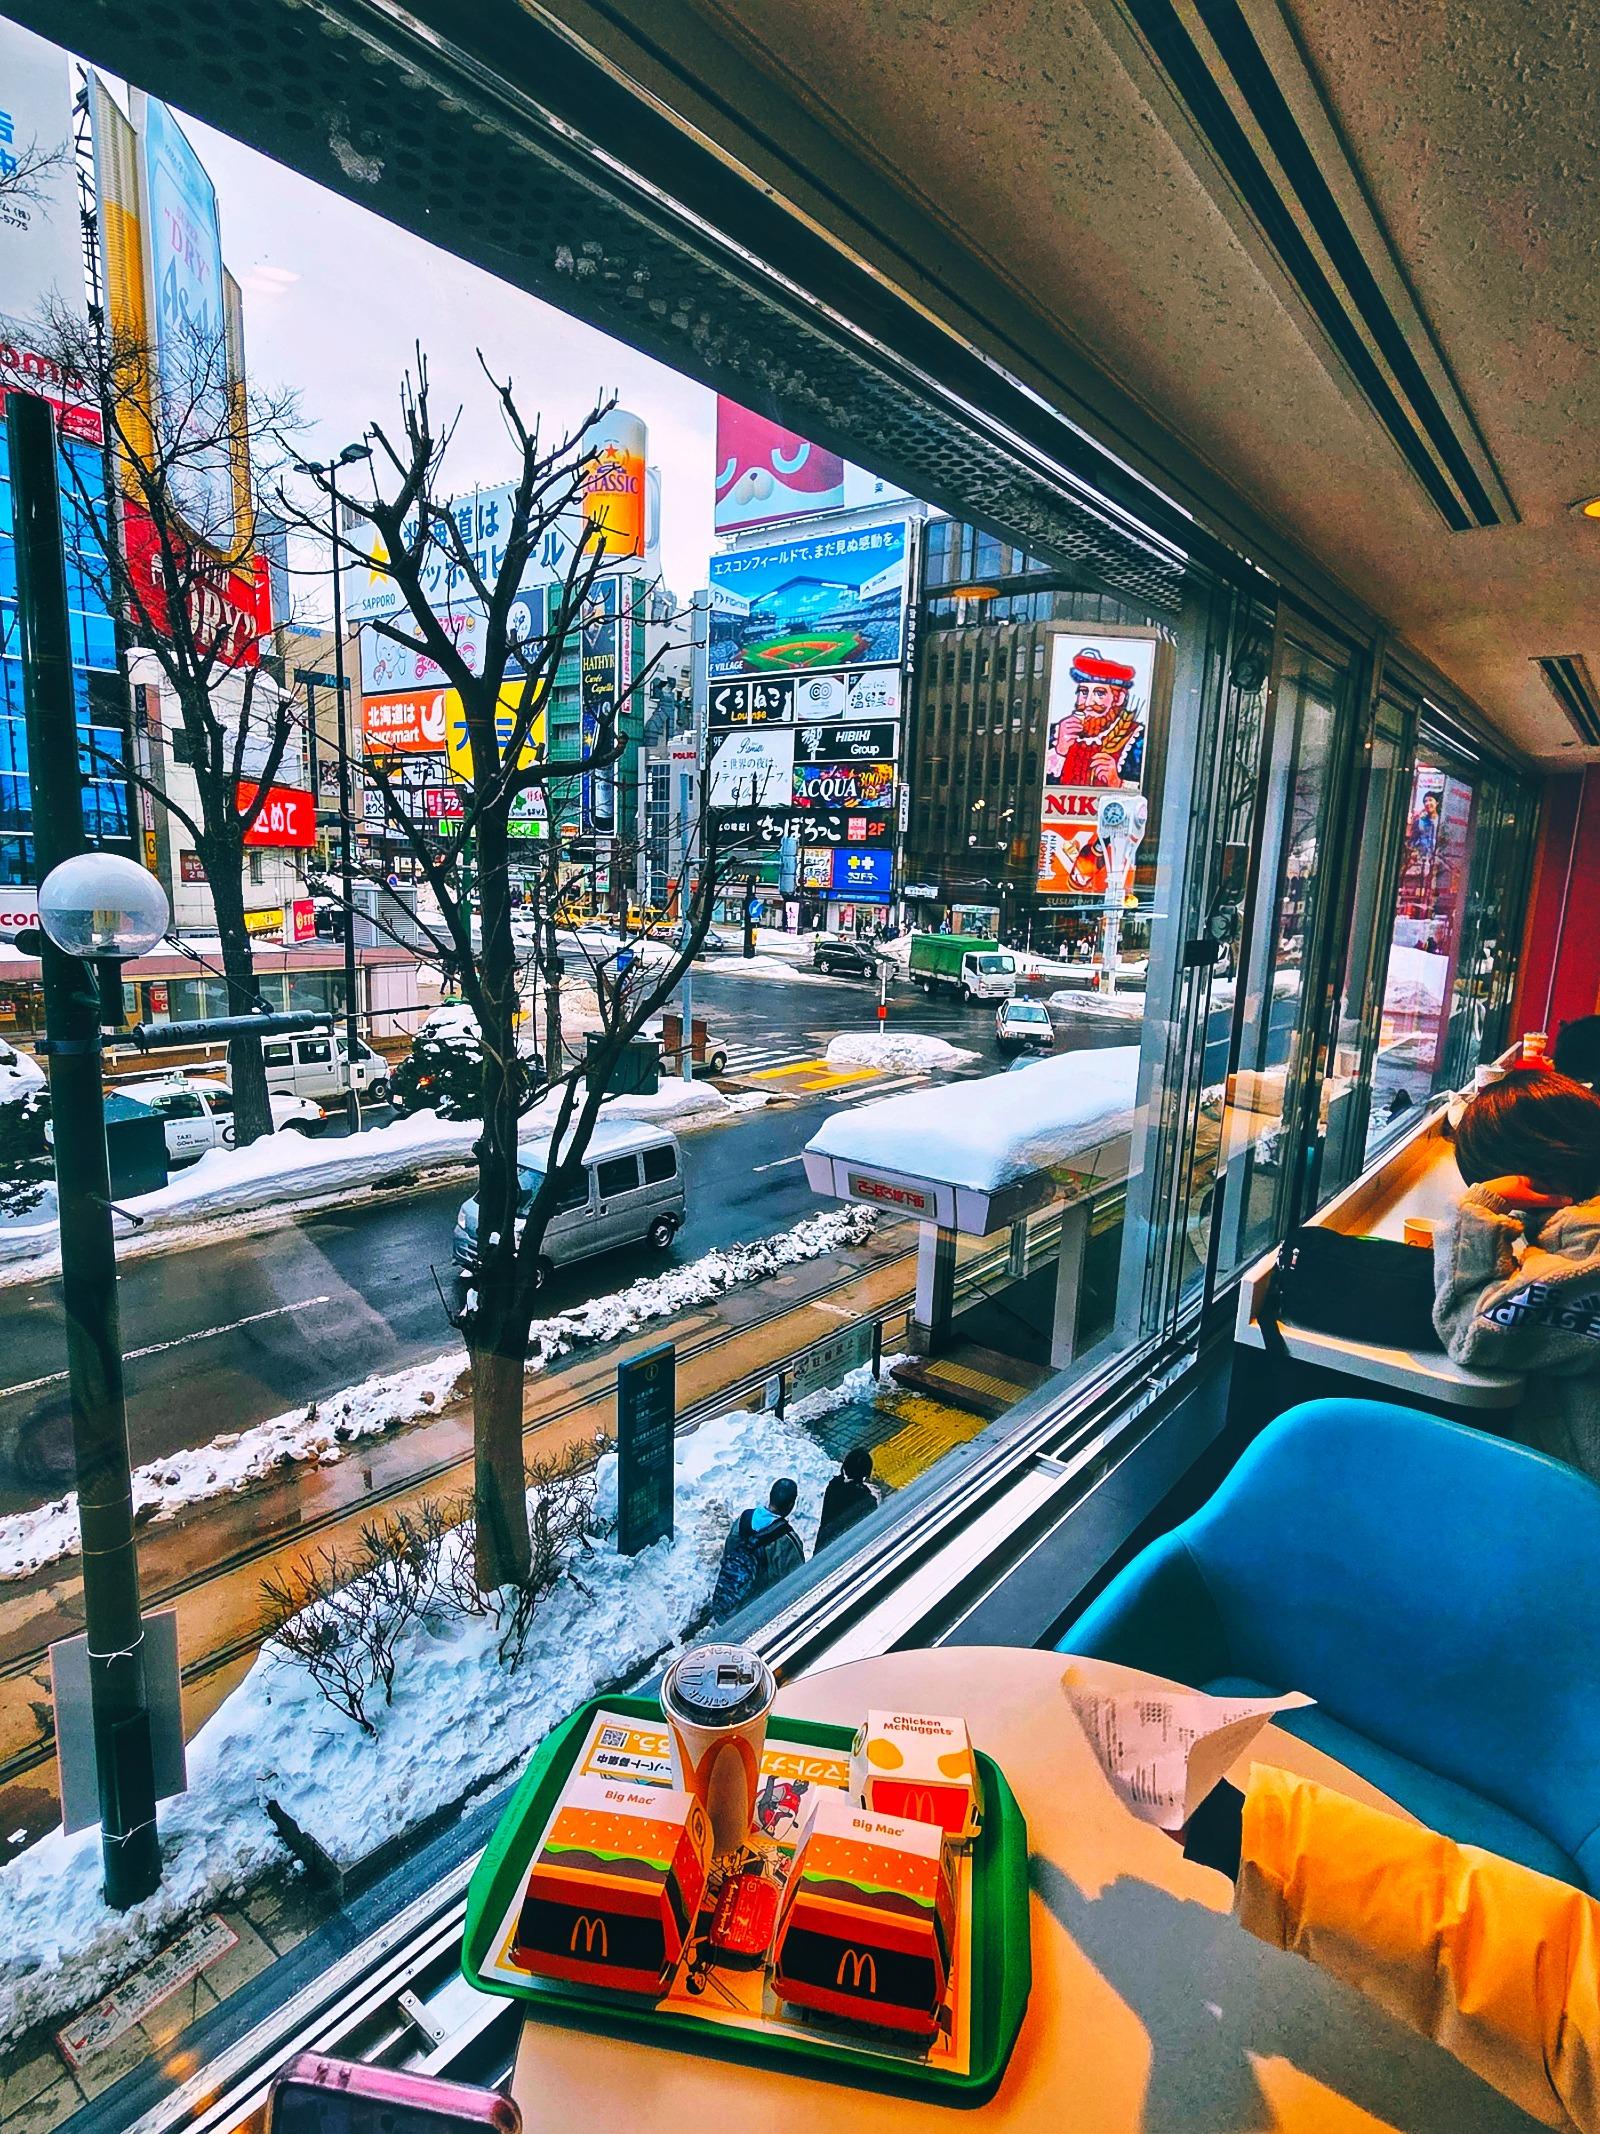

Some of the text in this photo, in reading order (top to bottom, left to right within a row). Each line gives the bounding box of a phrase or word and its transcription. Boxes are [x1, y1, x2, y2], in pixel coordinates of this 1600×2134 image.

[587, 473, 640, 495] CLASSIC
[714, 532, 900, 575] エスコンフィールドで、まだ見ぬ感動を。
[362, 593, 396, 611] SAPPORO
[715, 661, 744, 672] VILLAGE
[368, 703, 415, 727] 北海道は
[713, 736, 723, 747] 9F
[836, 730, 871, 742] HIBIKI
[850, 744, 880, 756] Group
[796, 778, 857, 801] ACQUA
[1044, 794, 1099, 816] NIK
[868, 823, 886, 836] 2F
[893, 1716, 941, 1727] Chicken
[883, 1722, 952, 1735] McNuggets
[604, 1790, 625, 1803] Big
[852, 1818, 873, 1832] Big
